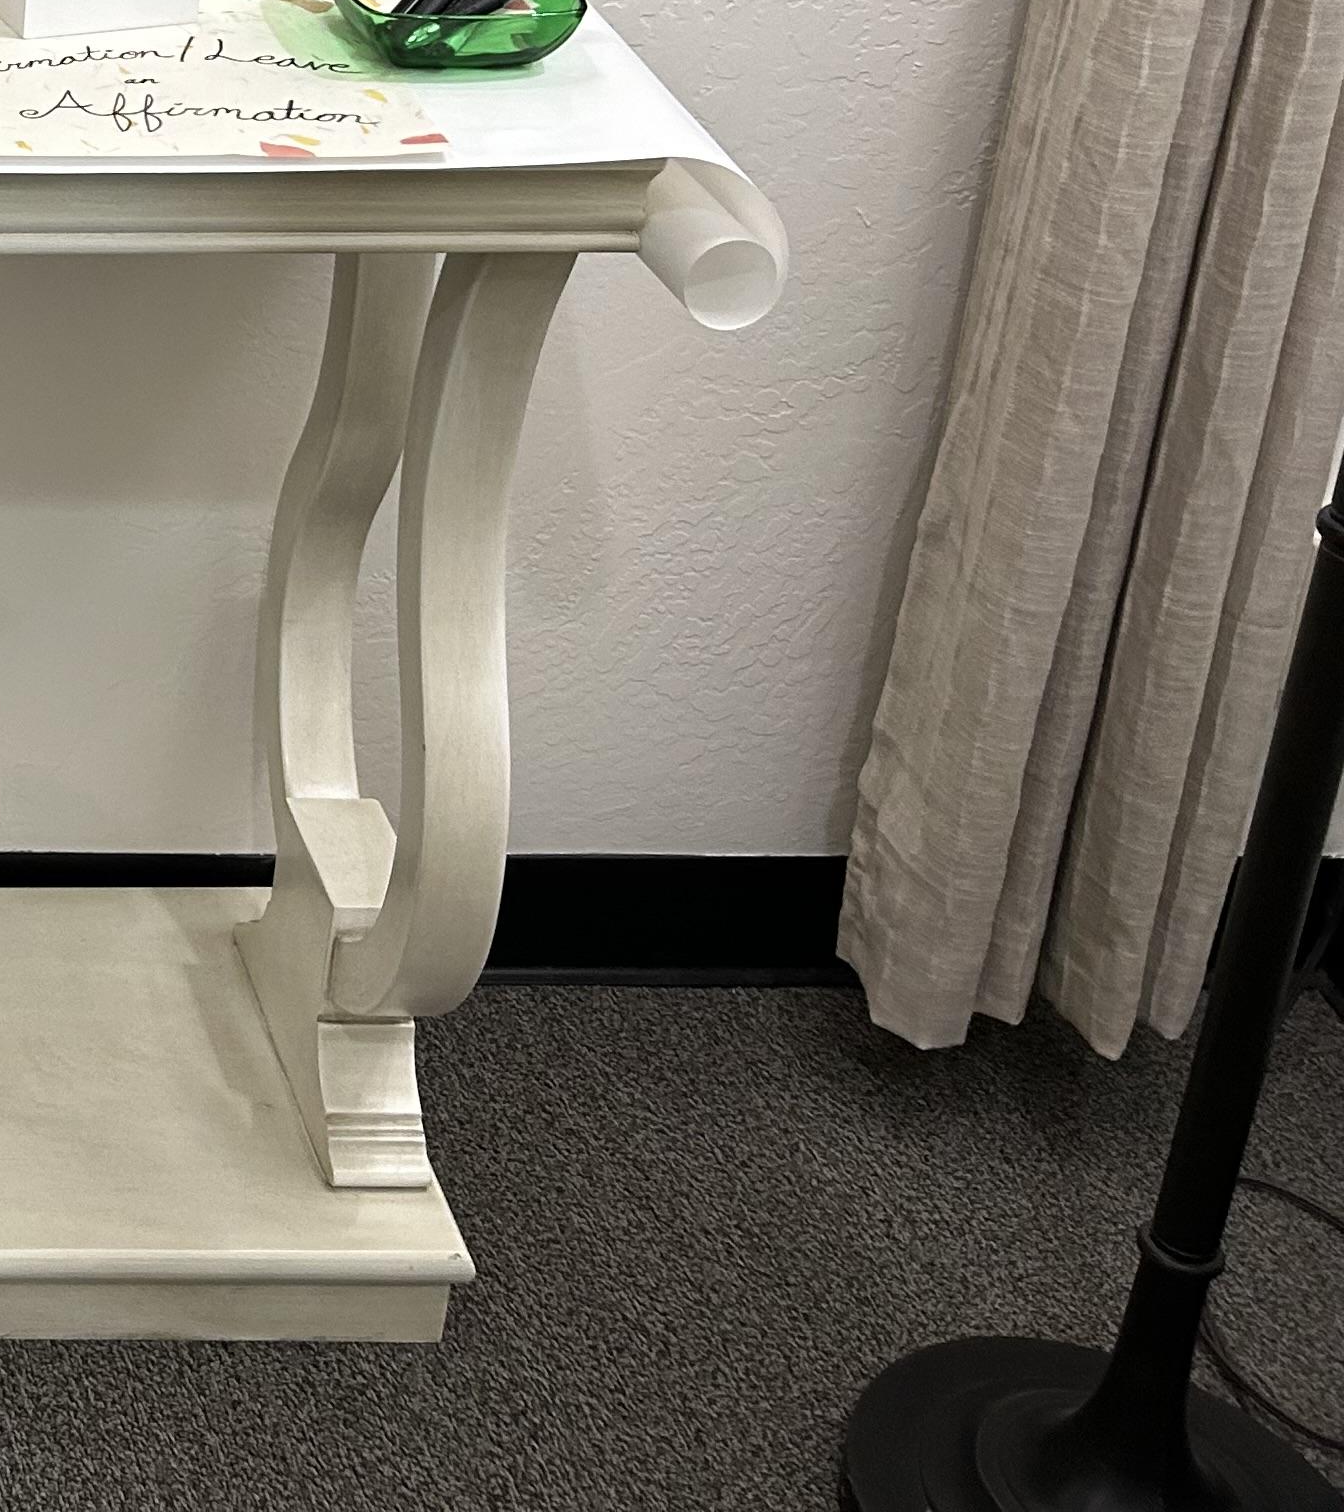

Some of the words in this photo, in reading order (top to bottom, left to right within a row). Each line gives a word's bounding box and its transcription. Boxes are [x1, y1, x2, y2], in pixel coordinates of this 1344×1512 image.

[205, 37, 367, 78] Leave
[123, 74, 160, 86] an
[18, 88, 380, 134] Affirmation
